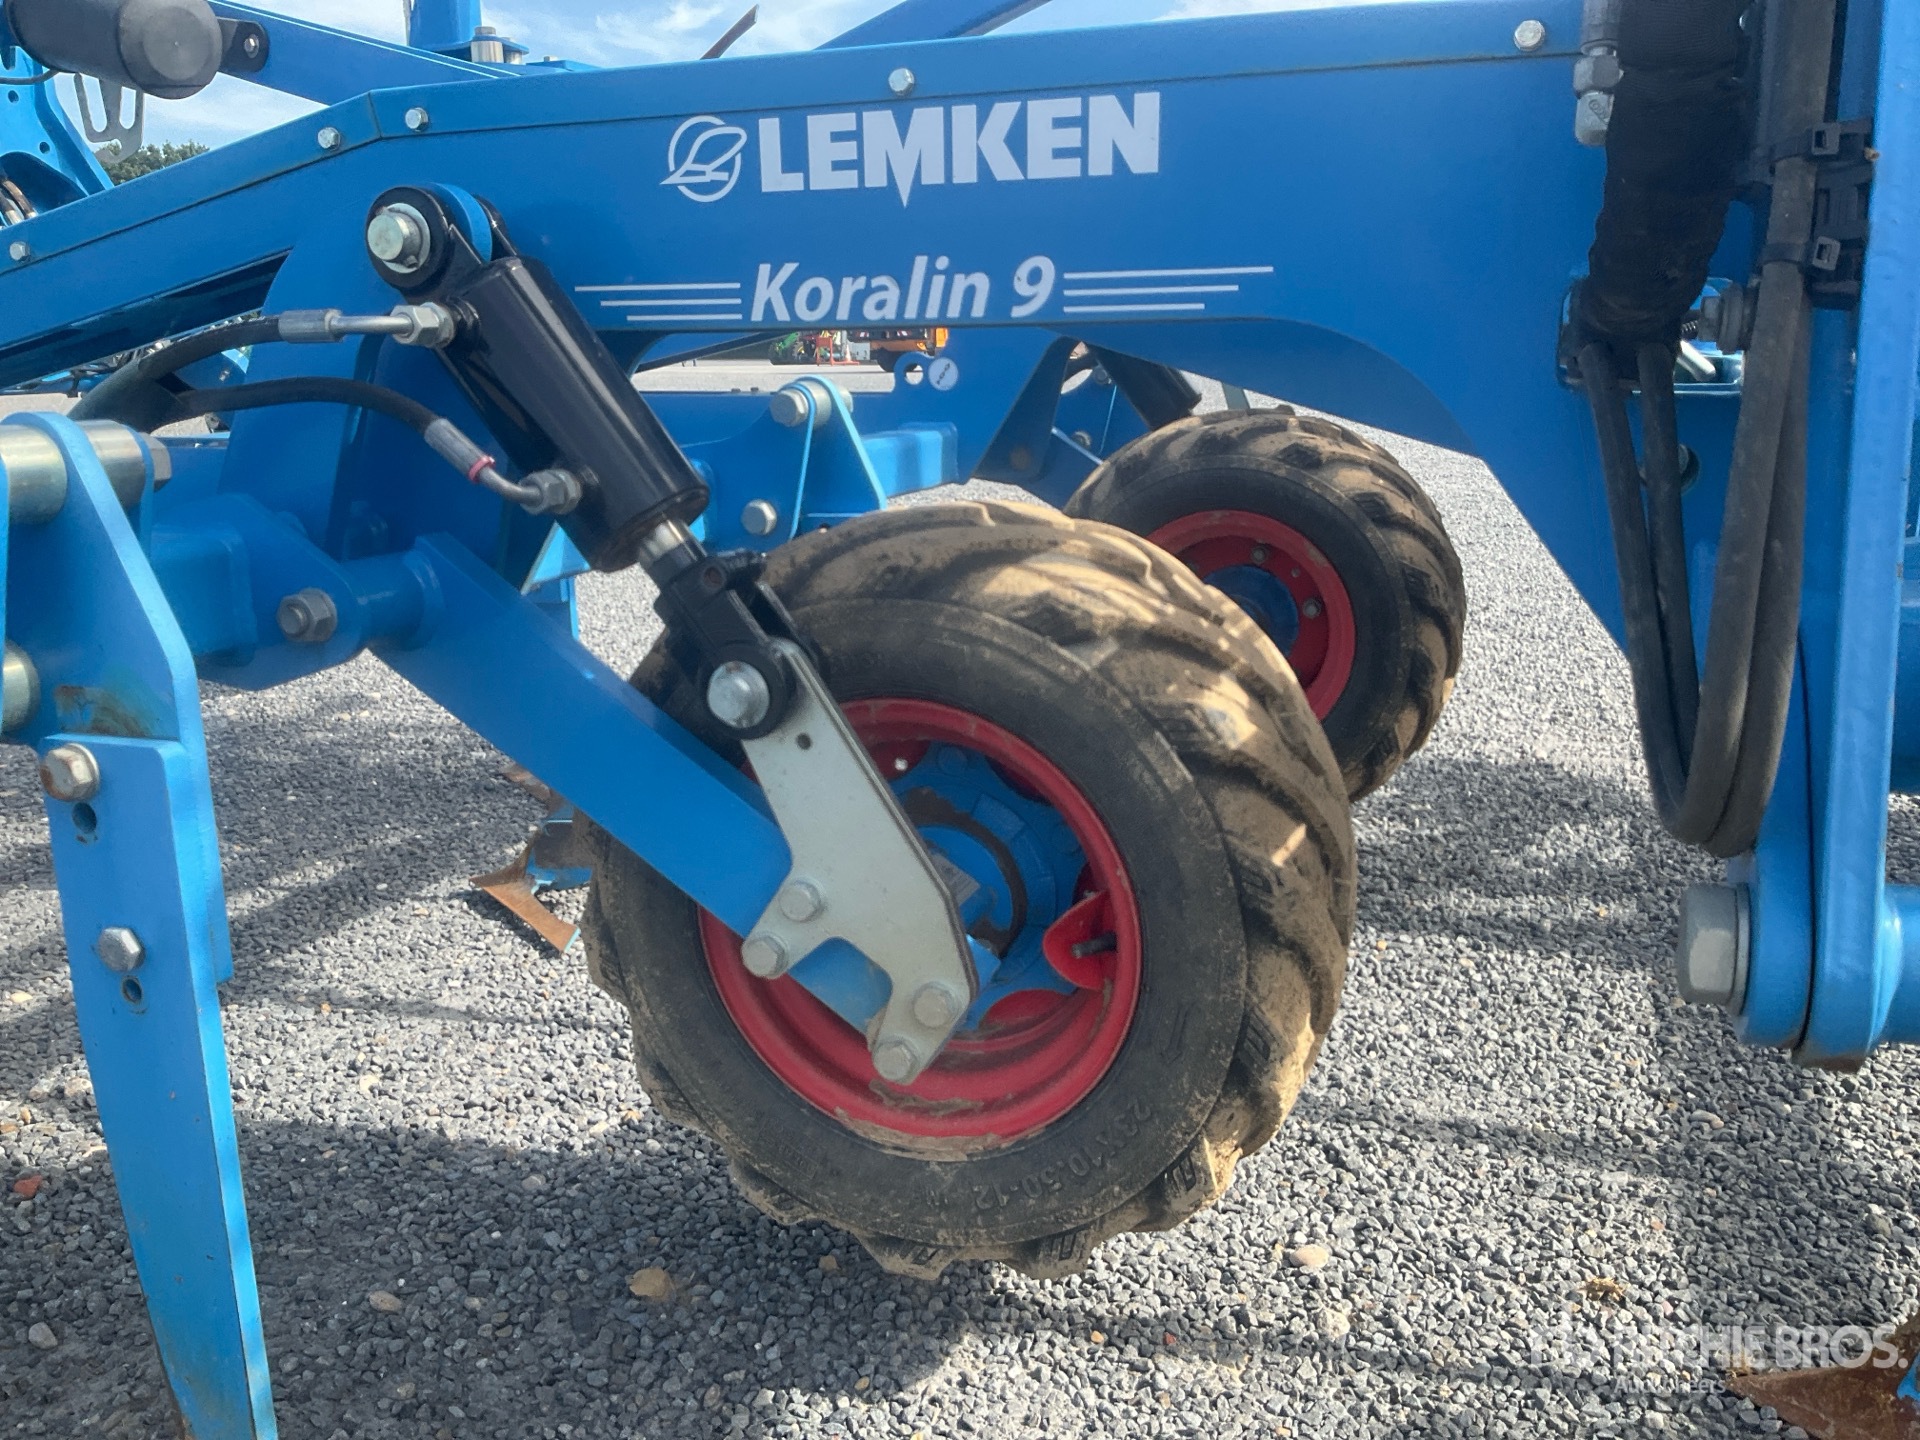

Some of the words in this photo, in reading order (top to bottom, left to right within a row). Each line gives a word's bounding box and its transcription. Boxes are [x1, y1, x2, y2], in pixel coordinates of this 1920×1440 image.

[758, 91, 1161, 208] LEMKEN
[751, 255, 990, 322] Koralin
[1010, 255, 1056, 318] 9
